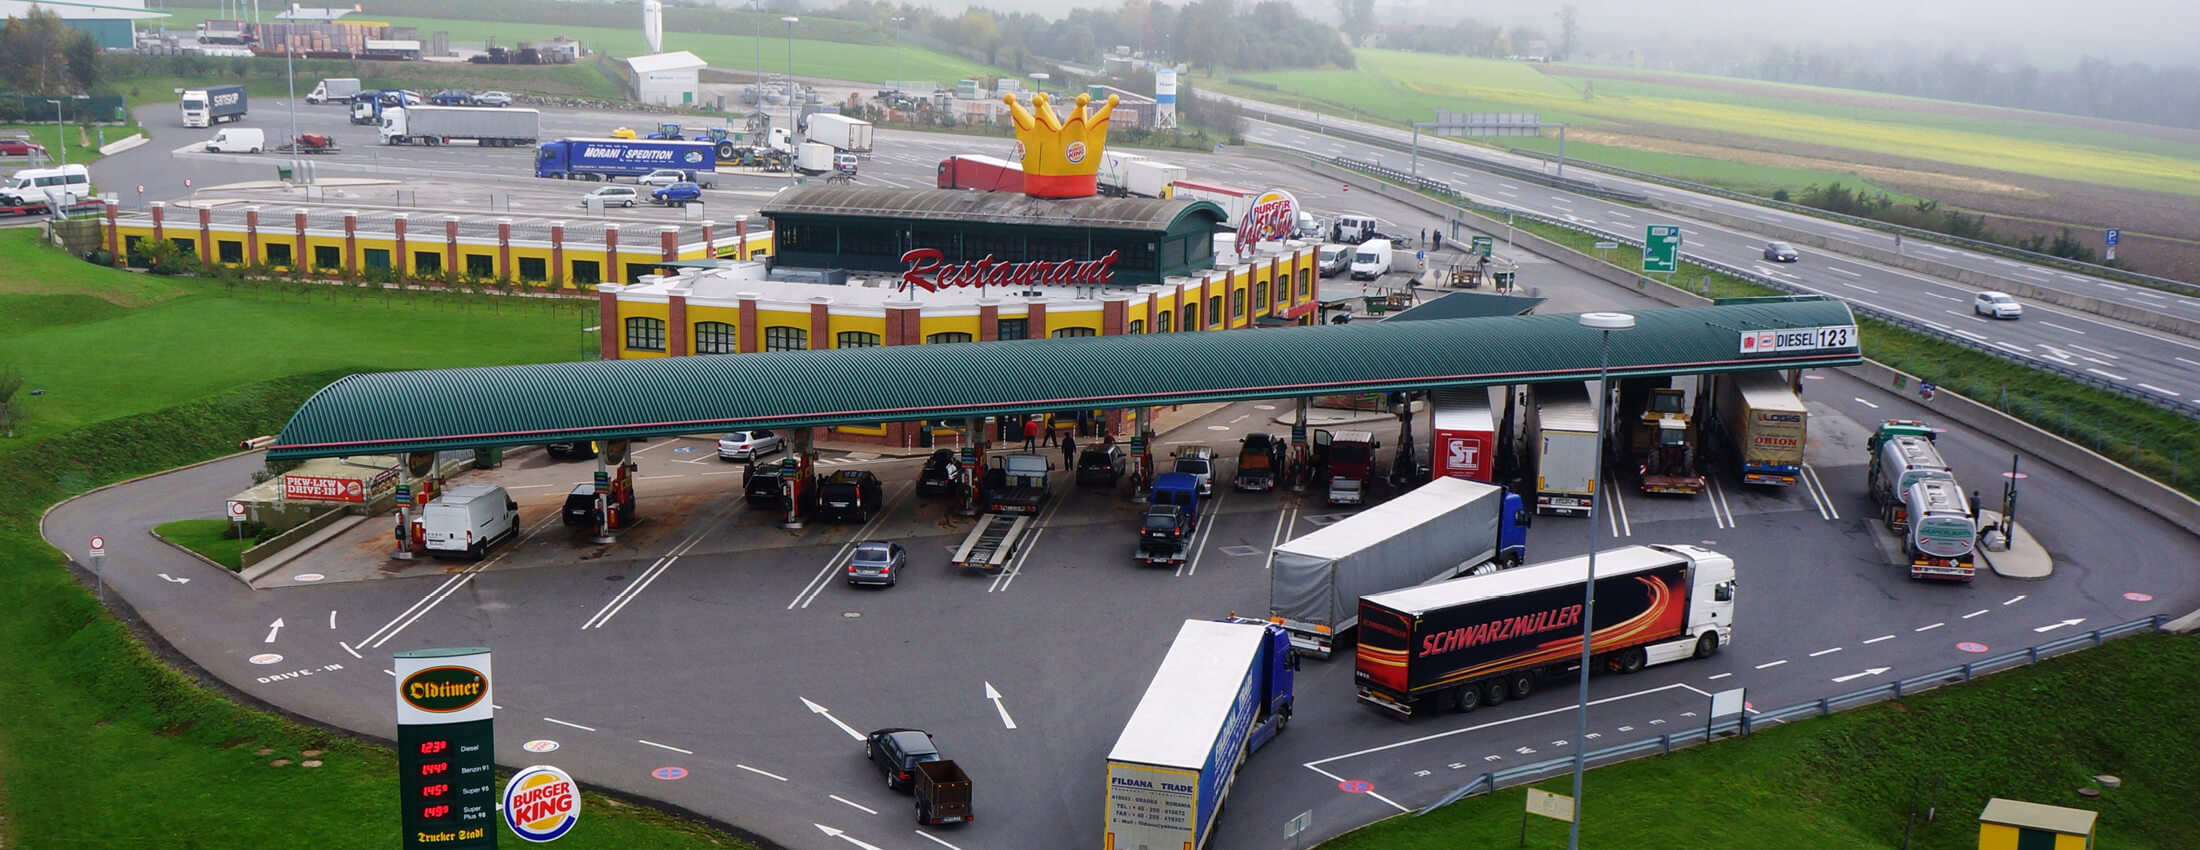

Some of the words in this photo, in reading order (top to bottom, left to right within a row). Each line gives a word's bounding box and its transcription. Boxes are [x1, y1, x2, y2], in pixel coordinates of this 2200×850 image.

[584, 147, 619, 158] MORANI
[625, 149, 674, 160] SPEDITION
[1254, 200, 1290, 215] BURGER
[899, 247, 1118, 293] Restaurant
[1776, 332, 1815, 347] DIESEL
[1820, 329, 1847, 347] 123
[1763, 413, 1801, 422] LOGIS
[1755, 437, 1797, 446] ORION
[287, 485, 336, 496] DRIVE-IN
[1418, 604, 1583, 658] SCHWARZMÜLLER
[410, 680, 480, 699] Oldtimer
[460, 745, 479, 753] Diesel
[461, 766, 482, 774] Benzin
[1111, 777, 1153, 788] FILDANA
[1161, 782, 1193, 793] TRADE
[513, 781, 570, 809] BURGER
[515, 794, 572, 827] KING
[417, 831, 456, 843] Trucker
[458, 827, 484, 840] Stadl
